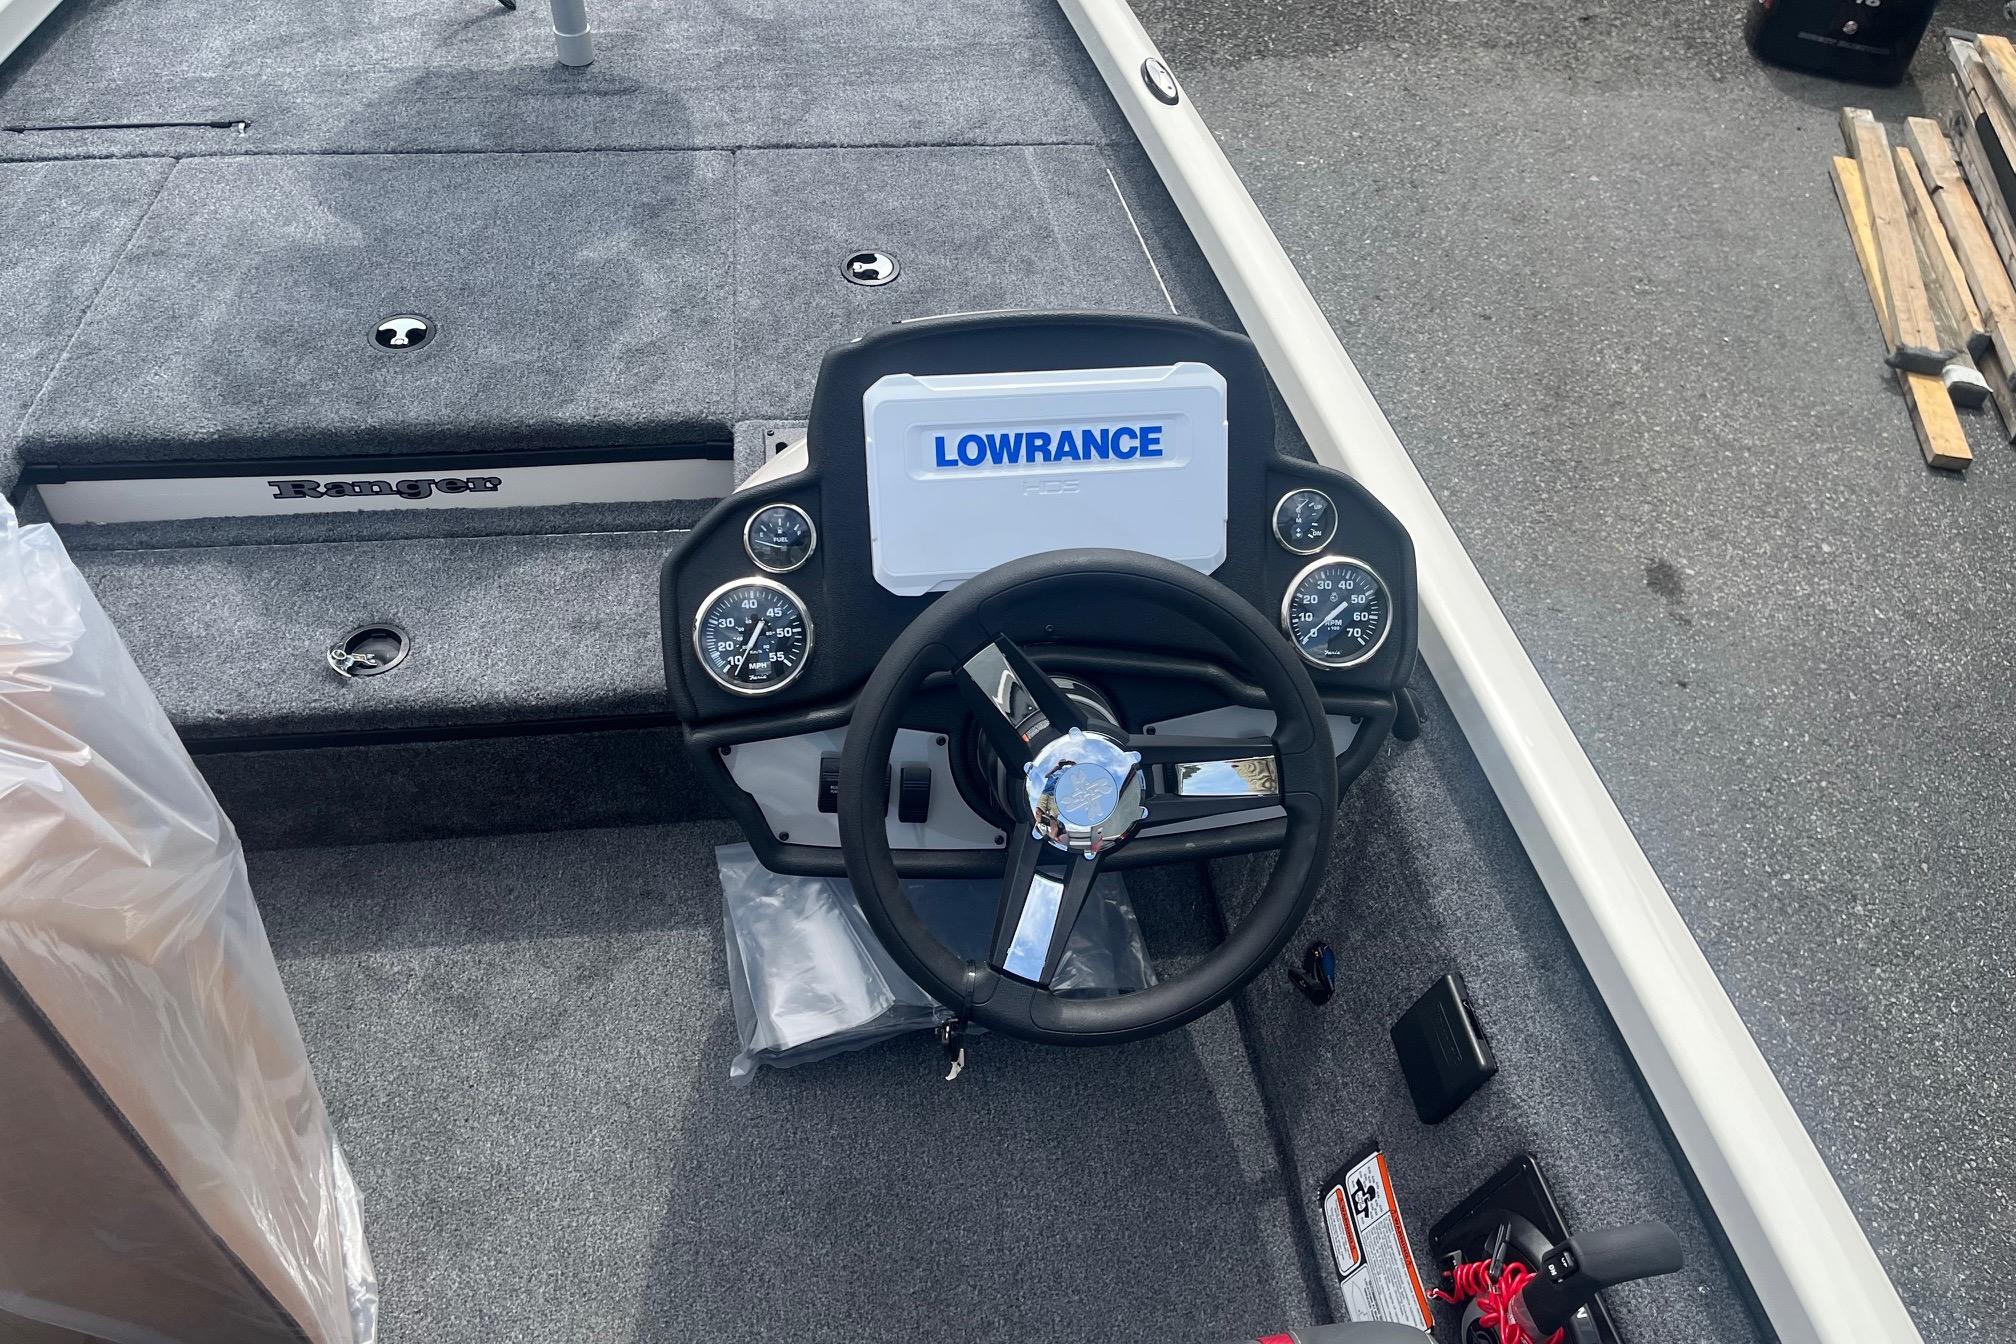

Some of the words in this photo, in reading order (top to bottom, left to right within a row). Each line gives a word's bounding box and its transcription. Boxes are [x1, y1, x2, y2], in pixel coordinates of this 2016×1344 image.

[935, 426, 1163, 468] LOWRANCE
[268, 477, 502, 499] Ranger
[1023, 479, 1080, 496] HDS
[1317, 580, 1332, 590] 30
[1338, 580, 1353, 590] 40
[1303, 595, 1318, 604] 20
[1351, 594, 1366, 603] 50
[742, 599, 757, 609] 40
[766, 607, 782, 617] 45
[1299, 612, 1313, 621] 10
[1353, 612, 1368, 621] 60
[719, 618, 734, 628] 30
[776, 627, 792, 637] 50
[1310, 628, 1318, 637] 0
[1347, 628, 1361, 637] 70
[718, 641, 734, 651] 20
[728, 655, 743, 665] 10
[769, 651, 785, 661] 55
[749, 662, 767, 670] MPH
[1548, 1264, 1558, 1276] DN
